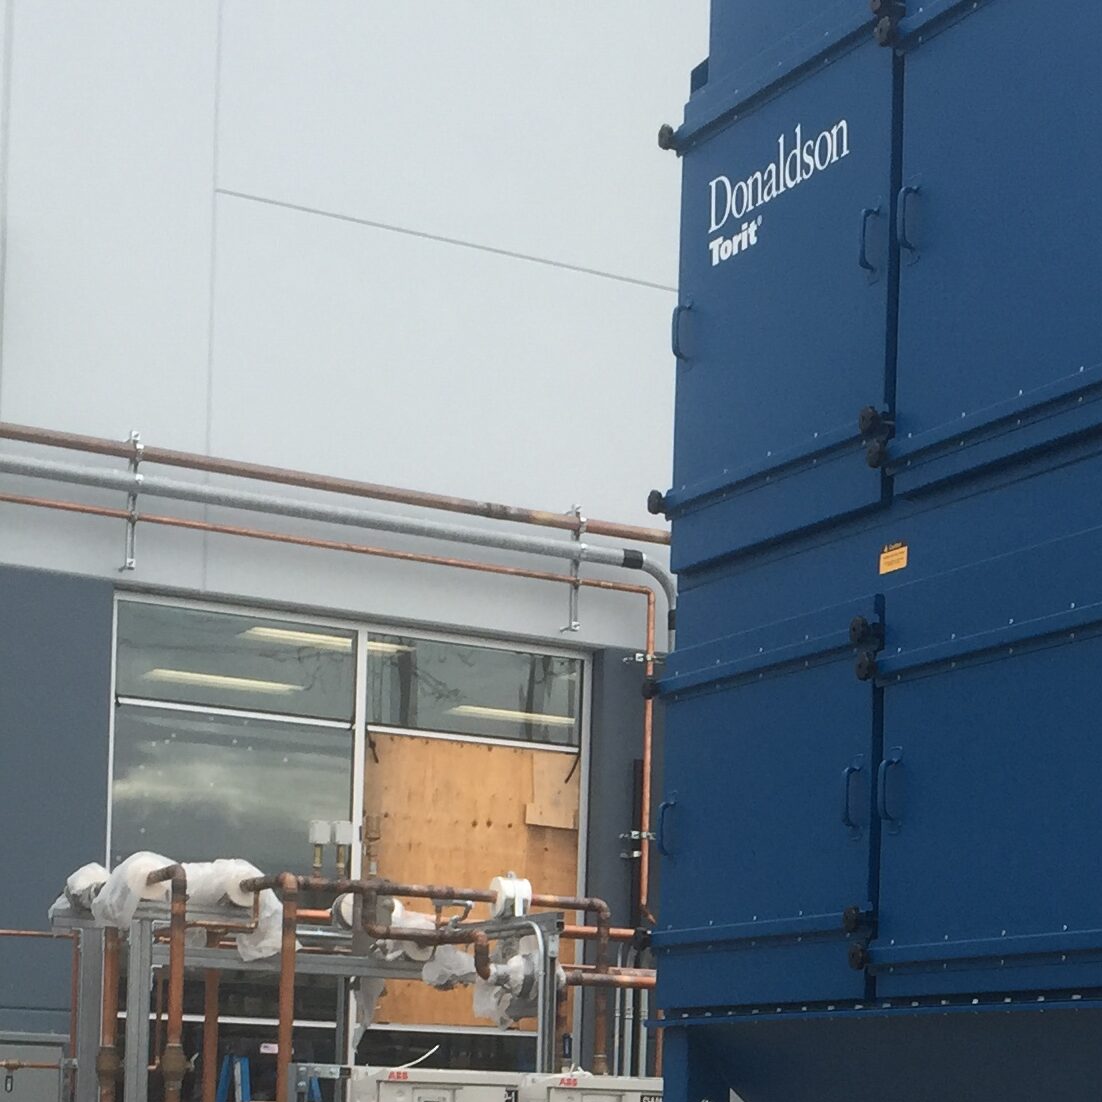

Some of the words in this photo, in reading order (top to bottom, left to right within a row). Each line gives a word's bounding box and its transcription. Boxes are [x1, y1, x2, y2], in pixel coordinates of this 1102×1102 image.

[708, 119, 850, 234] Donaldson
[388, 1072, 409, 1081] ABB
[559, 1077, 578, 1087] ABB
